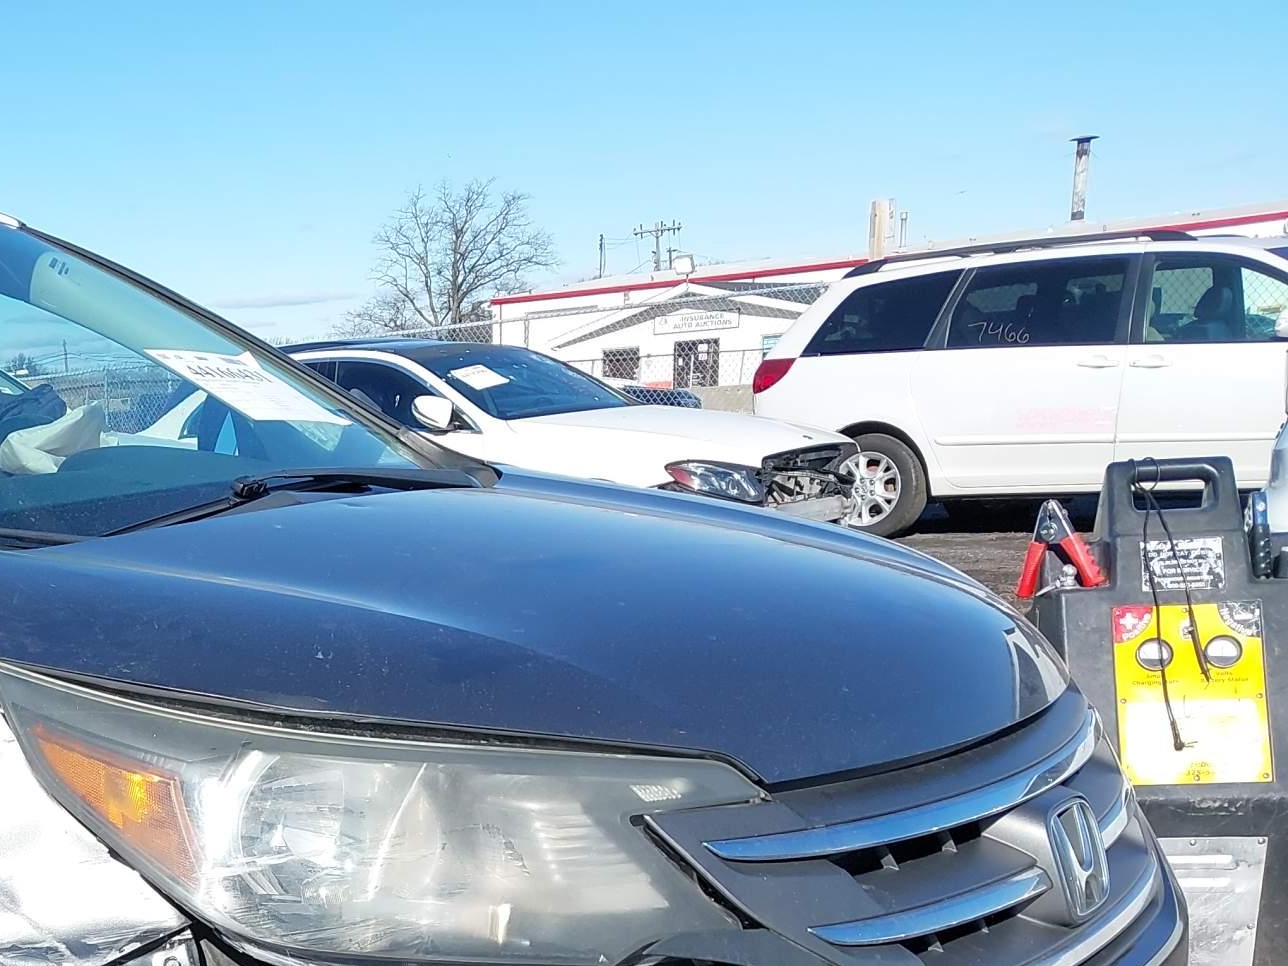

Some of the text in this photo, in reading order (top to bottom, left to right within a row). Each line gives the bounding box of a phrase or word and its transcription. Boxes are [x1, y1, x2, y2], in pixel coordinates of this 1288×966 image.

[681, 313, 725, 321] INSURANCE
[673, 321, 693, 329] AUTO
[695, 319, 733, 328] AUCTIONS
[967, 321, 1030, 344] 7466
